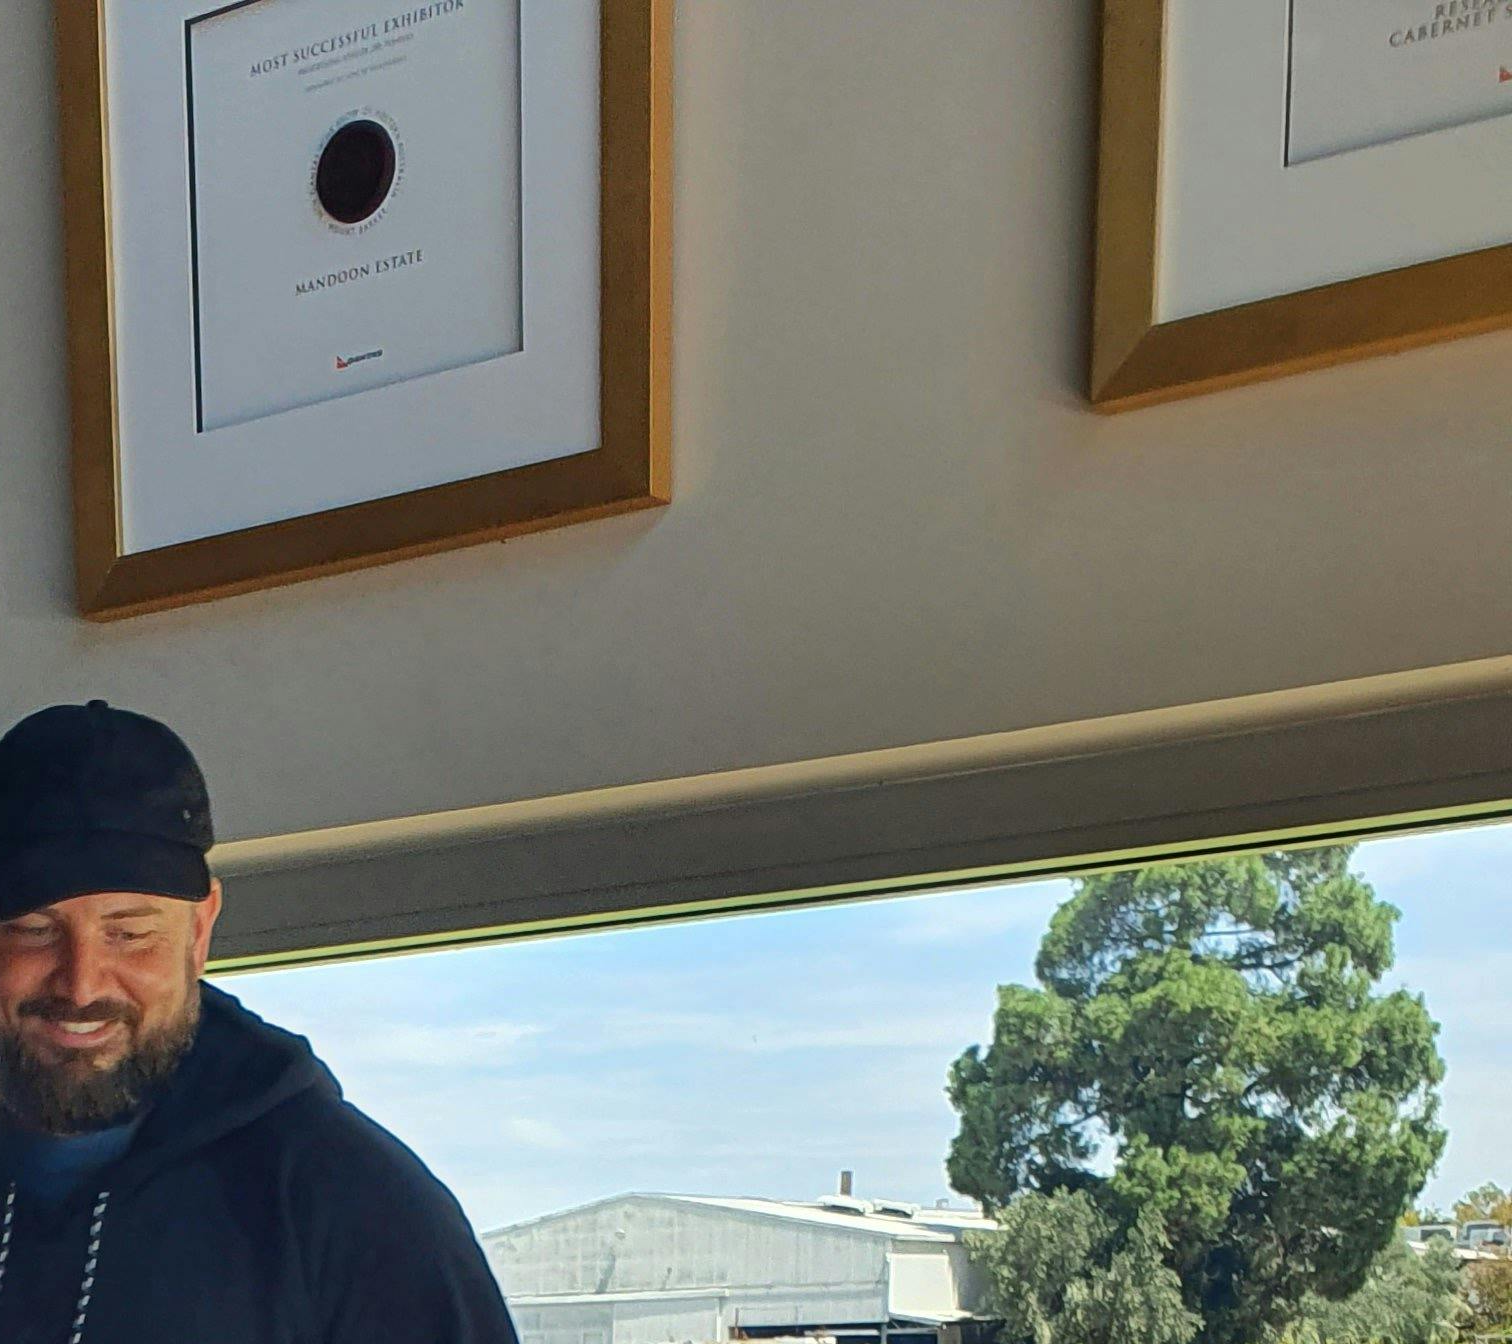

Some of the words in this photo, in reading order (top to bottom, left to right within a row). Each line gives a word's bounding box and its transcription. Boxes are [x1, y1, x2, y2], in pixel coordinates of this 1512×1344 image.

[250, 54, 288, 77] MOST
[293, 24, 378, 63] SUCCESSFUL
[384, 0, 465, 33] EXHIBITOR
[1389, 6, 1496, 48] CABERNET
[295, 264, 370, 297] MANDOON
[375, 249, 423, 273] ESTATE
